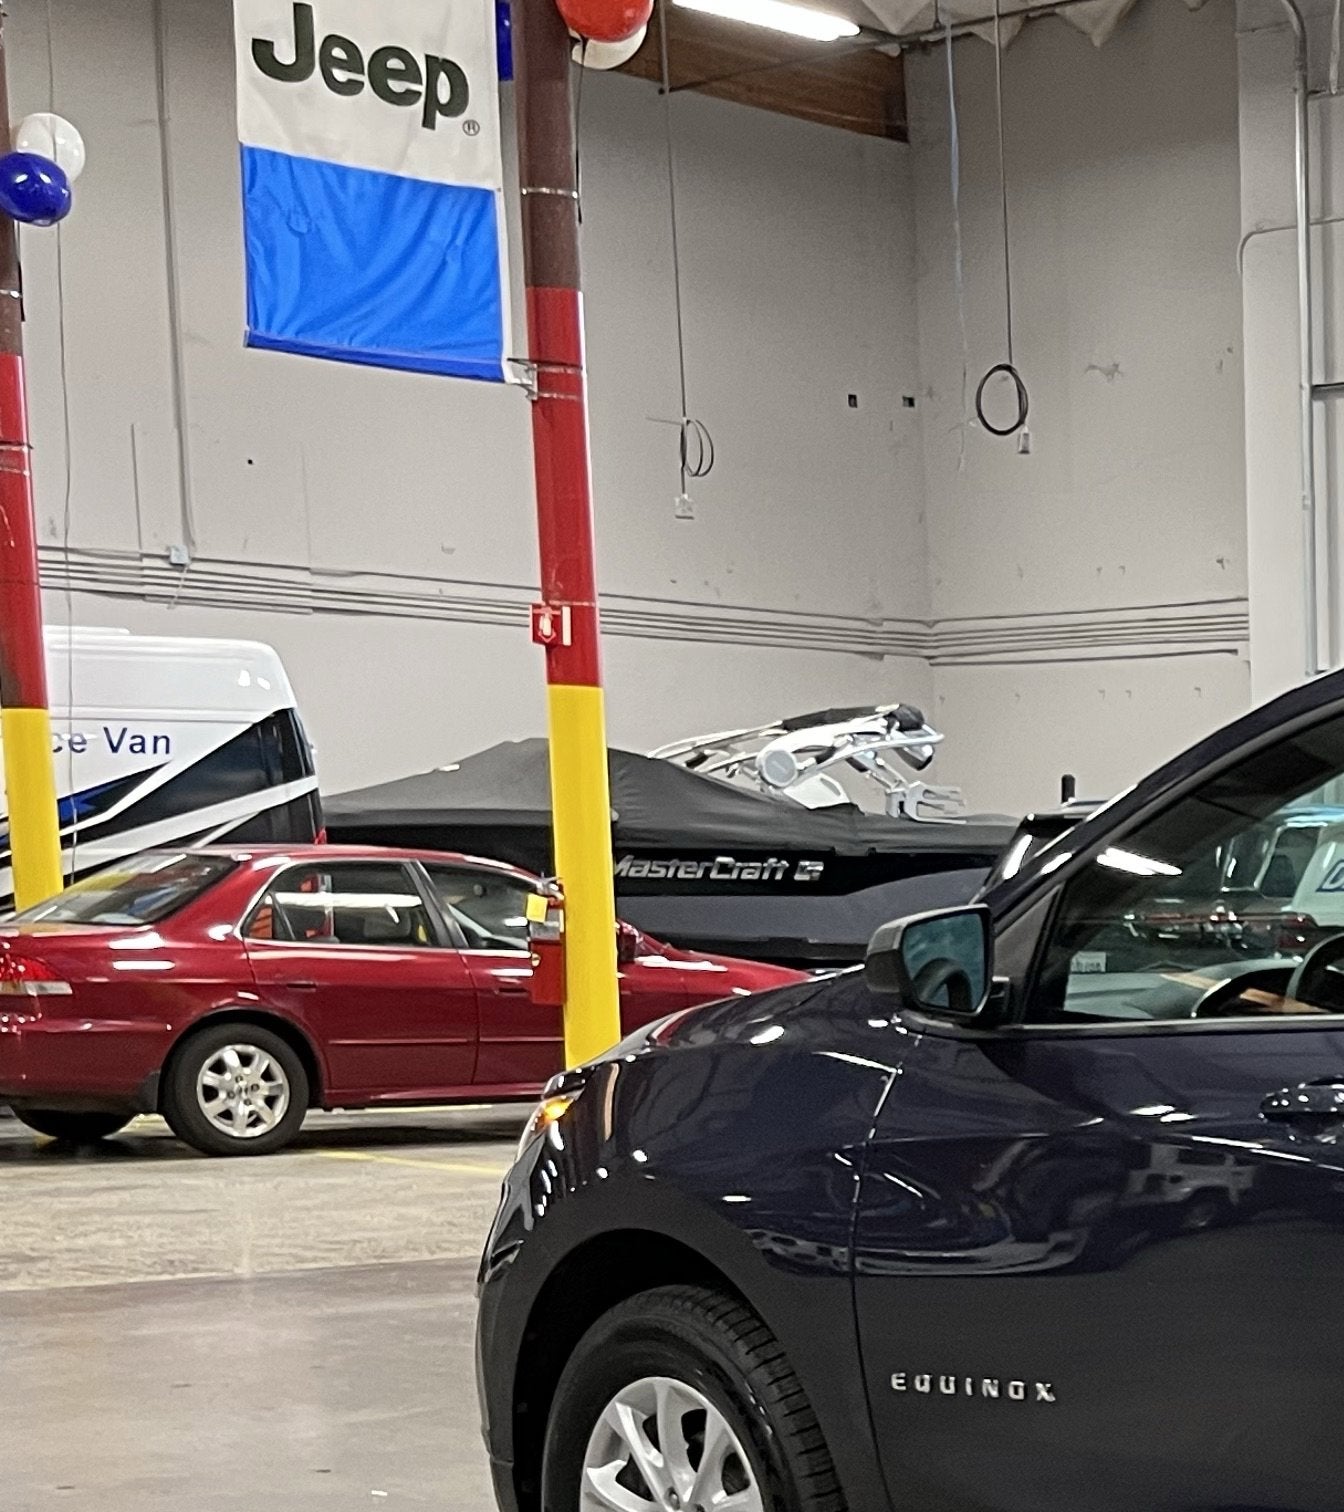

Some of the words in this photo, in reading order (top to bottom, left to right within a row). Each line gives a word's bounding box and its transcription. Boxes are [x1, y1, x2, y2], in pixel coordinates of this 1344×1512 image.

[251, 2, 470, 130] Jeep
[103, 726, 171, 755] Van
[890, 1372, 1056, 1402] EQUINOX
